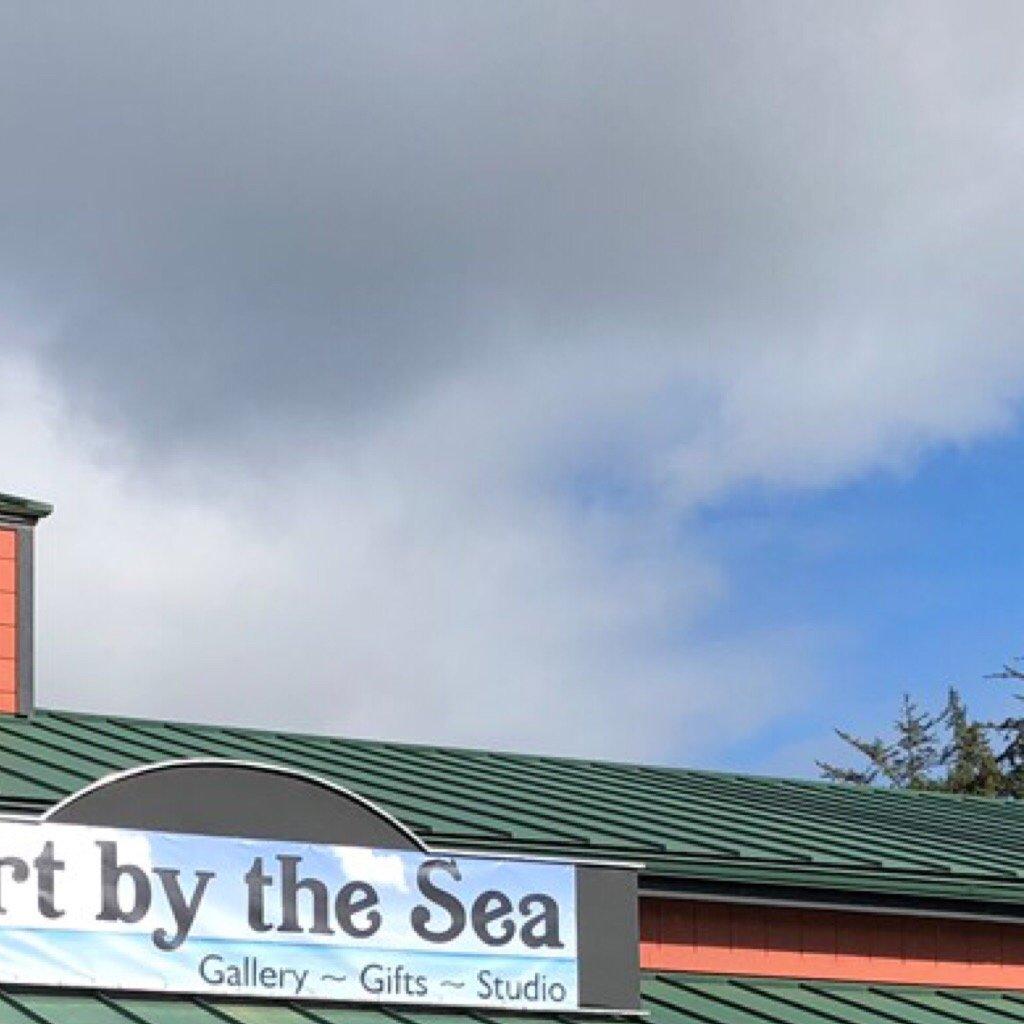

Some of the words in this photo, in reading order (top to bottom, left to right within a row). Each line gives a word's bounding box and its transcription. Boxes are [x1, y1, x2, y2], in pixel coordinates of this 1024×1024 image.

[95, 840, 216, 951] by
[244, 854, 381, 938] the
[411, 858, 565, 950] Sea
[199, 954, 309, 994] Gallery
[360, 964, 427, 996] Gifts
[477, 970, 567, 1002] Studio
